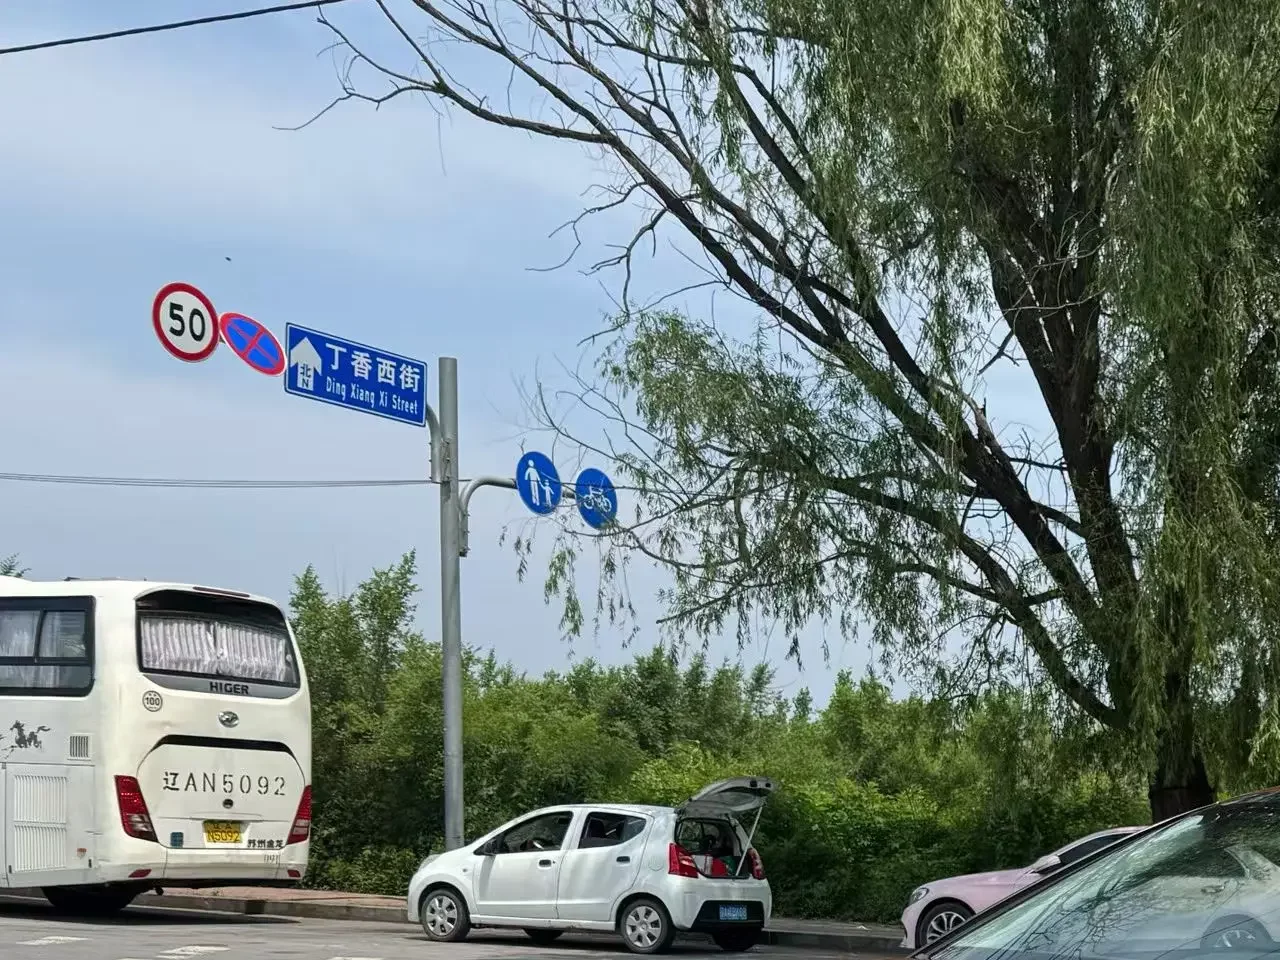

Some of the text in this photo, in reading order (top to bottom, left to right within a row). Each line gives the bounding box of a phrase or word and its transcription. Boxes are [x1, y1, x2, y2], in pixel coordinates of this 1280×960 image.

[169, 302, 206, 341] 50
[300, 363, 311, 378] 北
[325, 343, 420, 392] 丁香西街
[301, 378, 309, 388] N
[326, 376, 418, 414] Ding Xiang Xi Street
[209, 681, 249, 695] HIGER
[145, 697, 160, 706] 100
[207, 830, 240, 842] N5092
